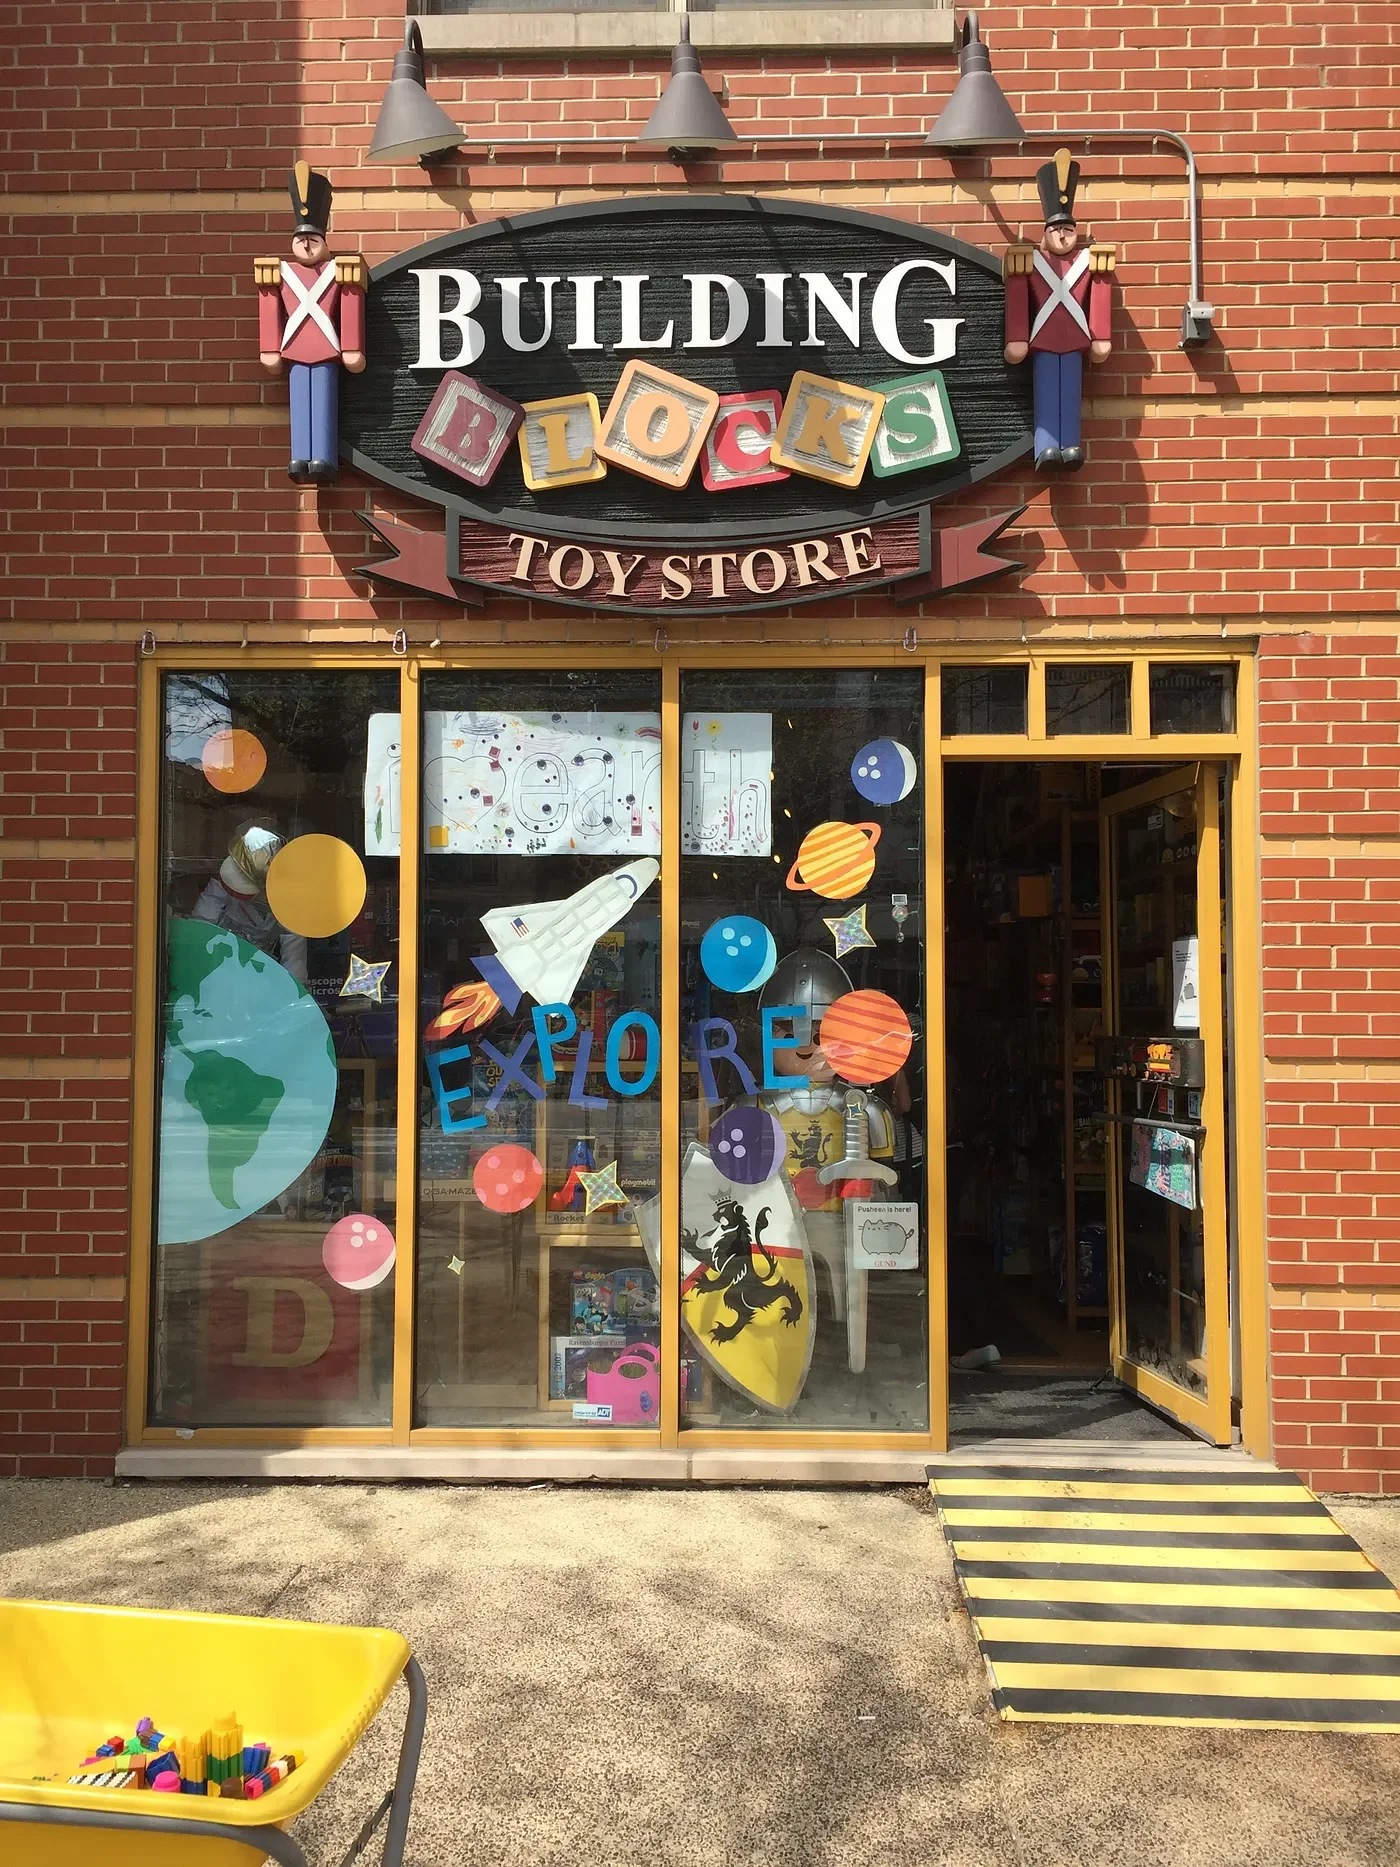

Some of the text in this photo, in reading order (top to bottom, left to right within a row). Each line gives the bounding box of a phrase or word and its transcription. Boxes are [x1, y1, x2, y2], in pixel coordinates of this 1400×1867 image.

[408, 259, 966, 369] BUILDING
[432, 388, 939, 476] BLOCKS
[506, 526, 883, 601] TOY STORE
[425, 1002, 810, 1136] EXPLORE
[620, 1178, 656, 1188] playmobil
[857, 1205, 886, 1213] Pusheen
[553, 1214, 585, 1222] Rocket
[874, 1260, 897, 1268] GUND
[231, 1276, 335, 1368] D
[568, 1338, 608, 1348] Ravensburger
[597, 1408, 611, 1417] ADT
